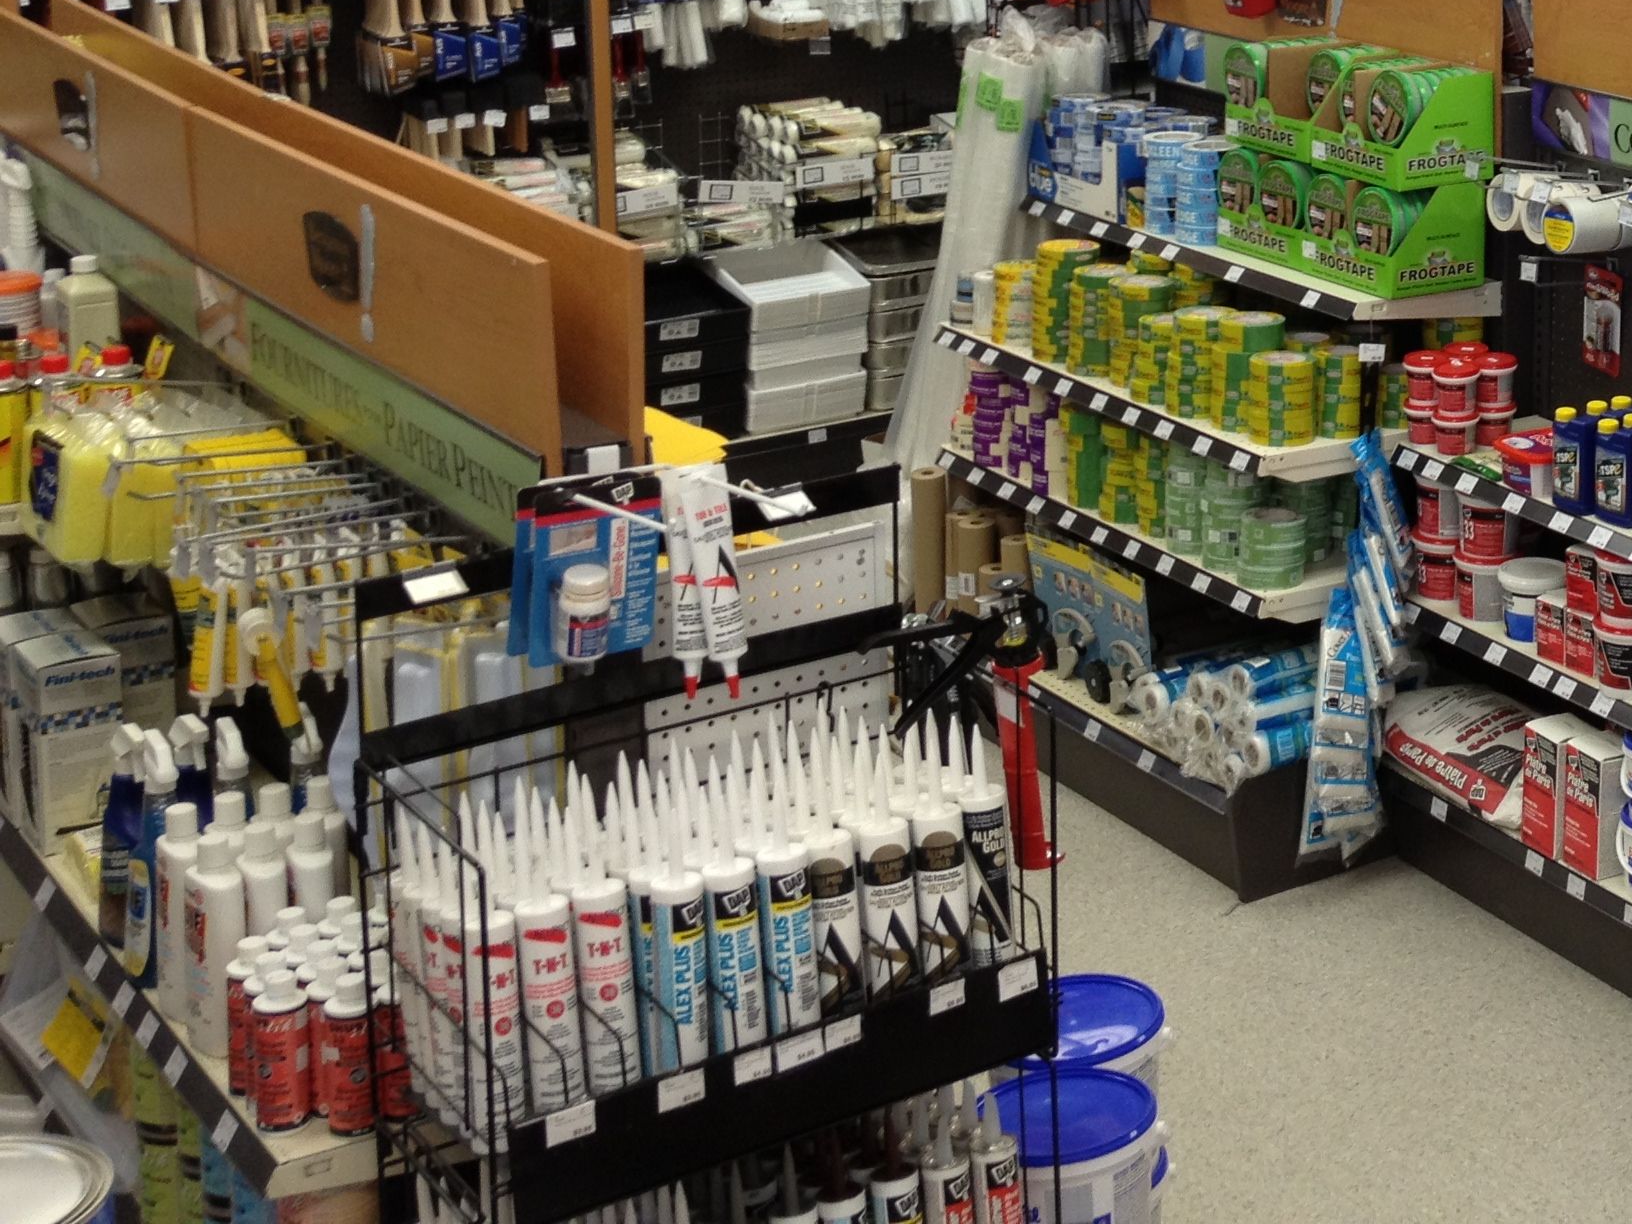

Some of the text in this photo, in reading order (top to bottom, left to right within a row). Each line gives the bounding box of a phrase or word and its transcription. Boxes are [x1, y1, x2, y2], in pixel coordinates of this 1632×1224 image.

[1400, 262, 1475, 282] FROGTAPE
[727, 887, 750, 908] DAP
[674, 945, 691, 984] PLUS
